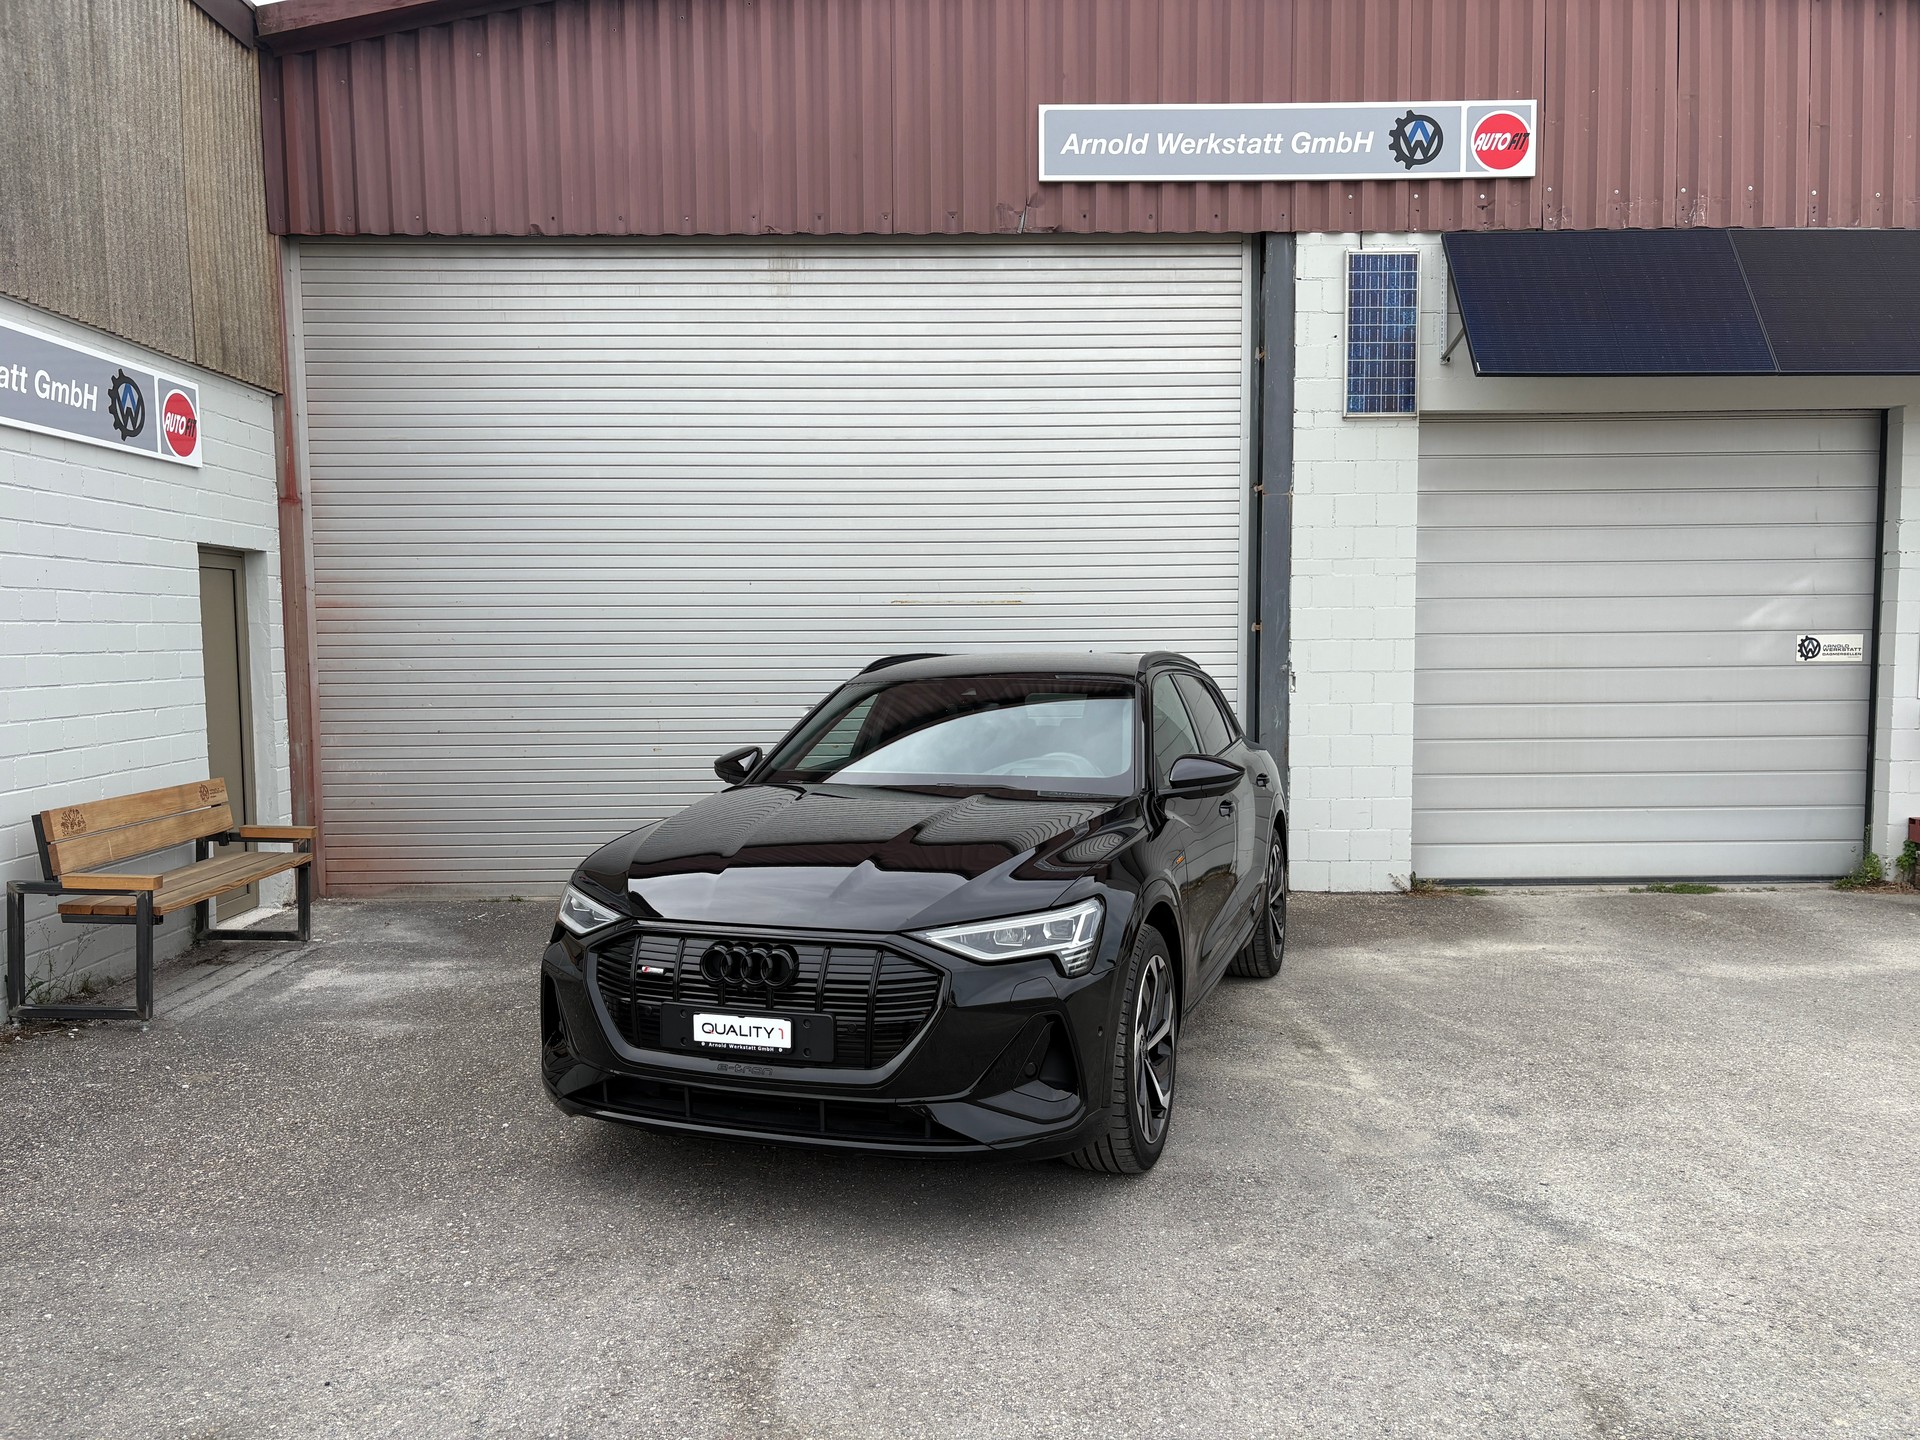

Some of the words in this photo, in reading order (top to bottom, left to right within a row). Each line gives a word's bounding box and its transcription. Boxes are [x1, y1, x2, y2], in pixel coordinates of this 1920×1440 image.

[1060, 132, 1149, 155] Arnold
[1157, 131, 1283, 155] Werkstatt
[1290, 130, 1374, 154] GmbH
[34, 369, 98, 412] GmbH
[701, 1022, 775, 1039] QUALITY
[728, 1043, 757, 1051] Werkstatt
